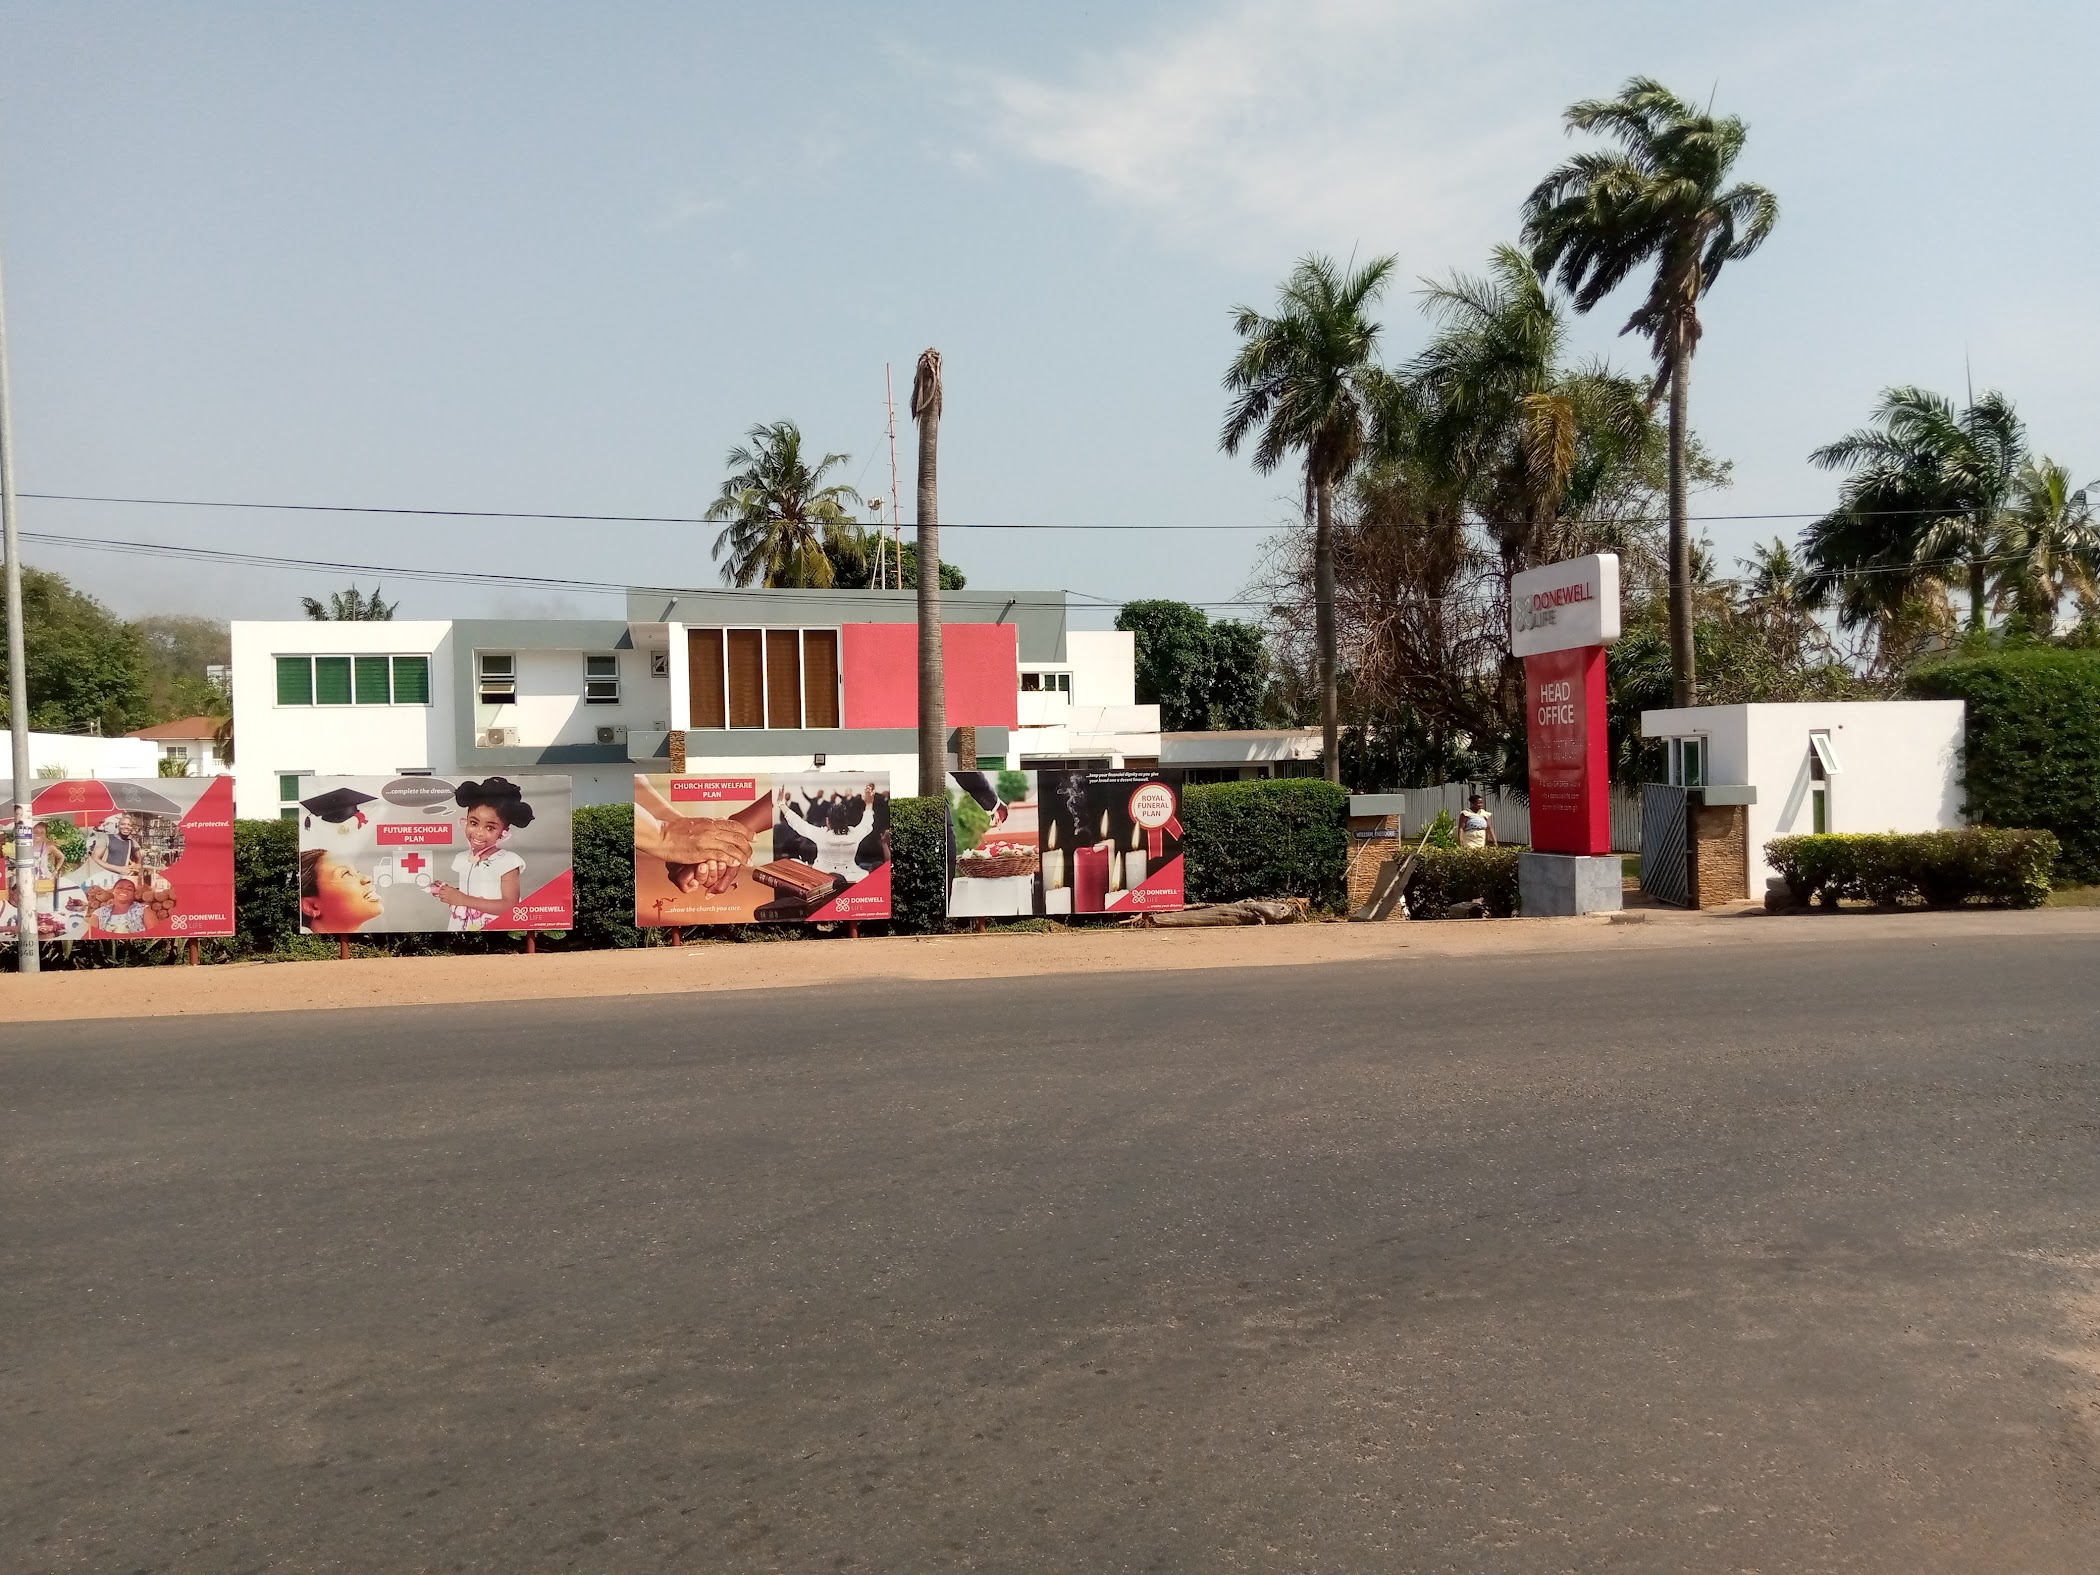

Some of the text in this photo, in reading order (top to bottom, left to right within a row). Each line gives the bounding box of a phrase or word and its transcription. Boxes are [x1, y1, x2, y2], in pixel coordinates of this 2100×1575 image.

[1533, 582, 1593, 611] DONEWELL
[1534, 610, 1557, 628] LIFE
[1540, 682, 1570, 703] HEAD
[1538, 704, 1574, 726] OFFICE
[673, 782, 703, 790] CHURCH
[197, 820, 230, 828] protected.
[851, 896, 884, 904] DONEWELL
[716, 905, 727, 913] you
